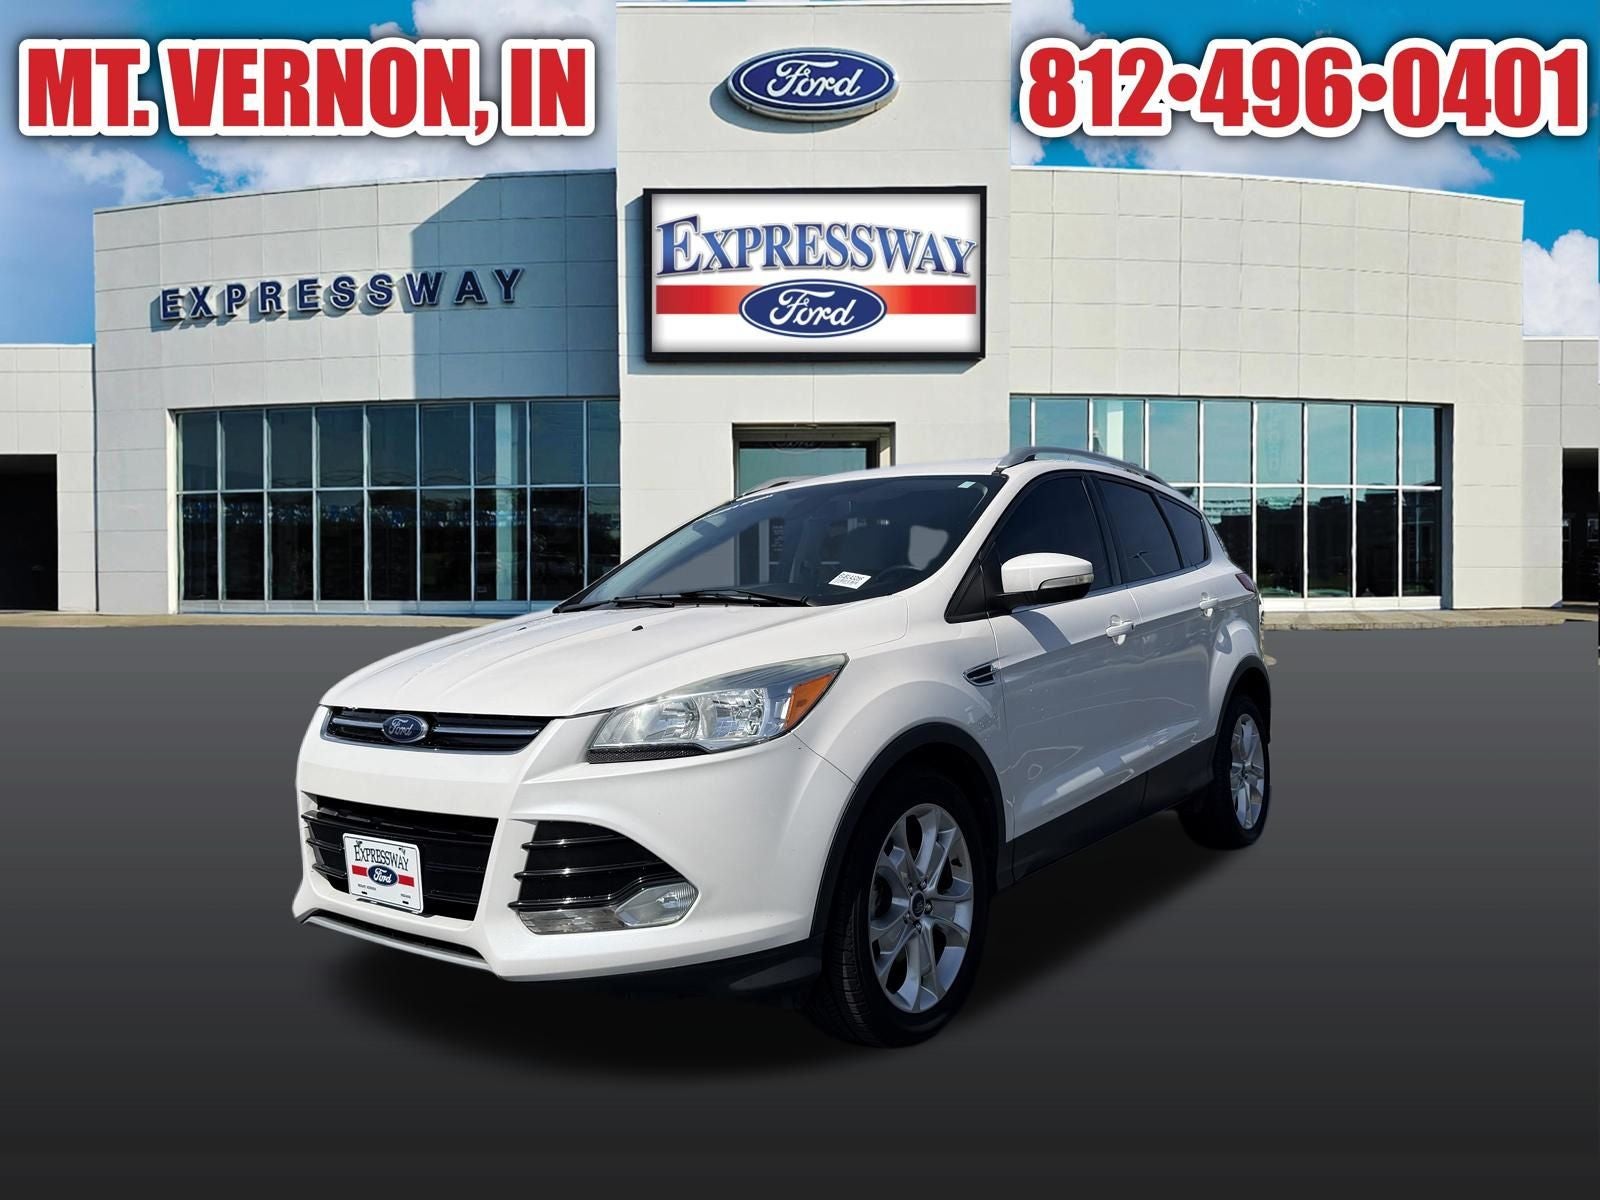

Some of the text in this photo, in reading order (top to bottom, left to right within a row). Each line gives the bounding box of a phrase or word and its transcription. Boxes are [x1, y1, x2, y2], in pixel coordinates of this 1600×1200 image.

[766, 59, 863, 98] Ford
[656, 214, 977, 277] EXPRESSWAY
[160, 267, 525, 321] EXPRESSWAY
[769, 288, 856, 327] Ford
[388, 718, 414, 736] Ford
[354, 844, 409, 871] EXPRESSWAY
[373, 867, 393, 884] Ford
